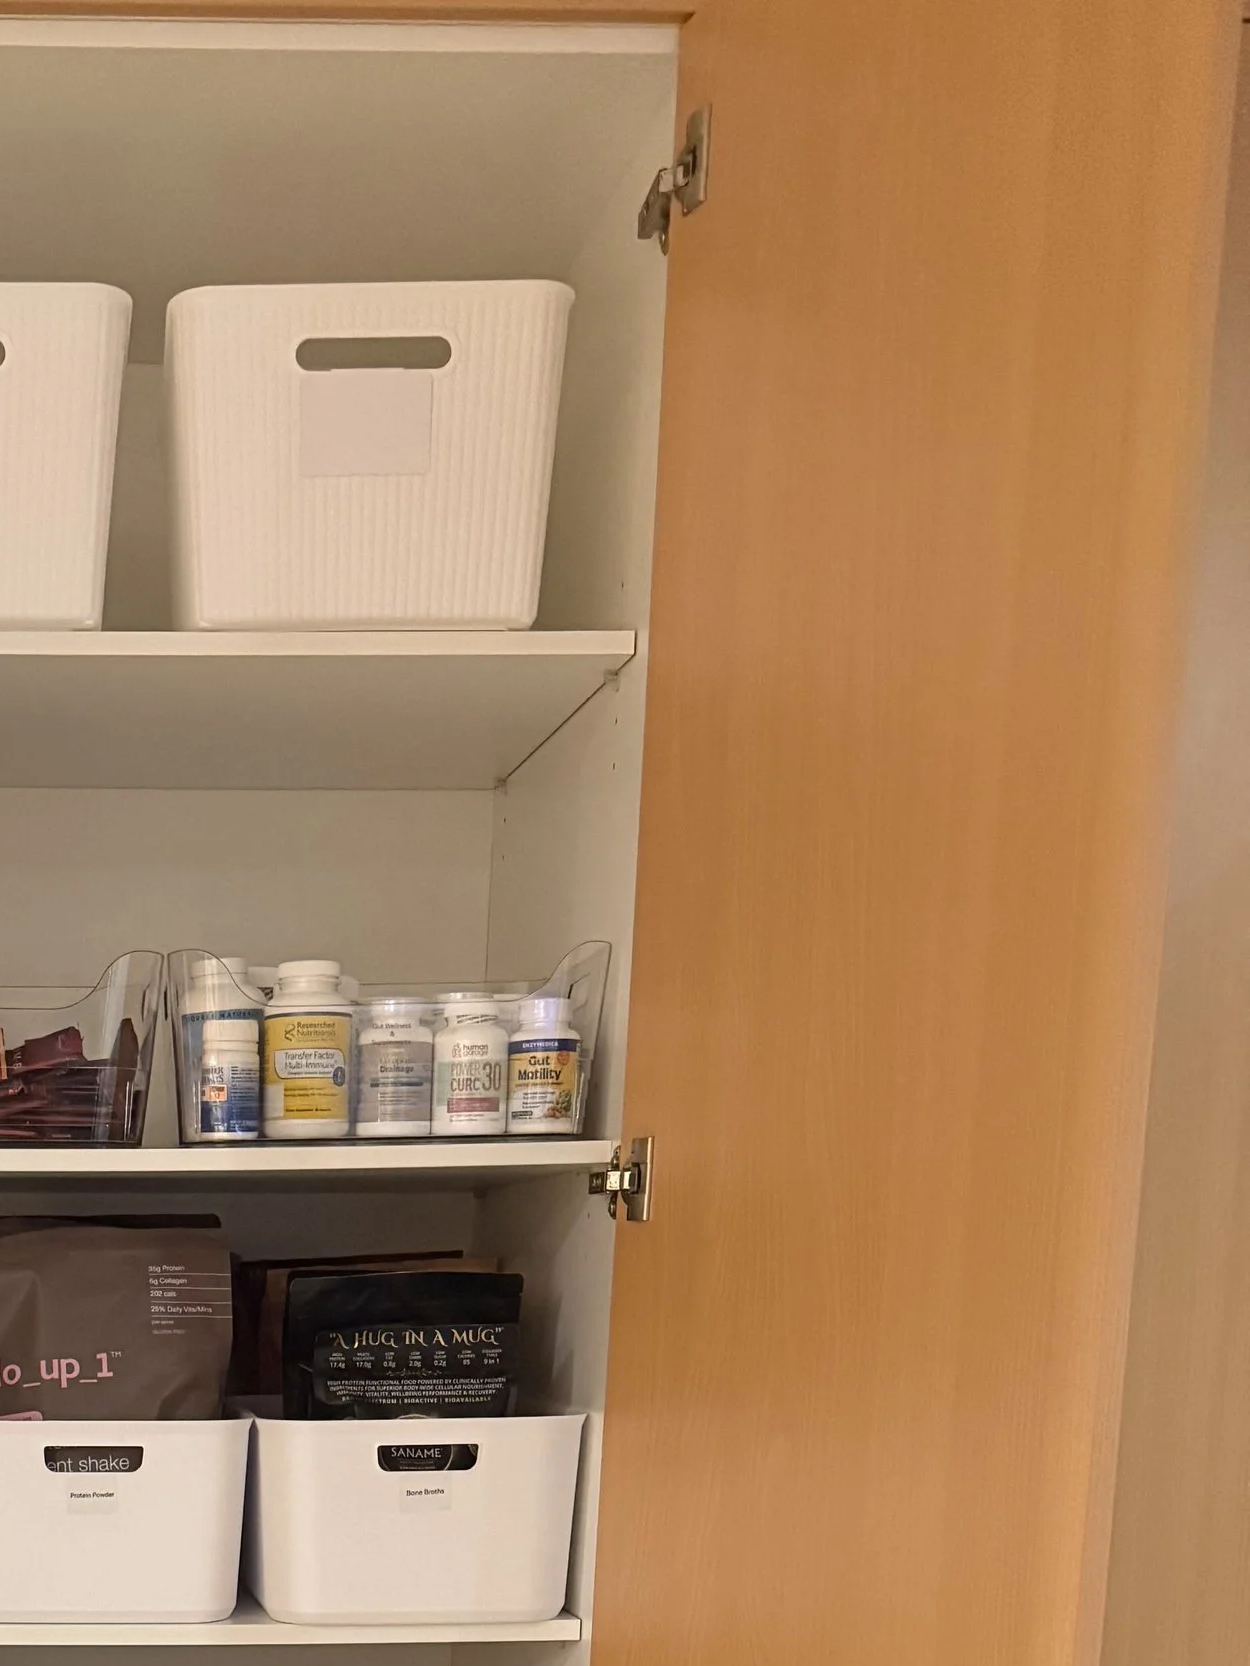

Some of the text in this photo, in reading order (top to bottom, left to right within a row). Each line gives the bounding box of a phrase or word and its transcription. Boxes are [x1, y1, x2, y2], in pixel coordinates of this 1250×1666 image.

[284, 1052, 335, 1061] Transfer Factor
[529, 1055, 550, 1066] Gut
[451, 1063, 482, 1076] POWER
[518, 1068, 561, 1081] Motility
[483, 1063, 501, 1091] 30
[451, 1078, 480, 1091] CURC
[353, 1330, 398, 1348] HUG
[402, 1329, 428, 1346] IN
[432, 1329, 448, 1347] A
[391, 1447, 442, 1458] SANAME
[78, 1455, 130, 1472] shake
